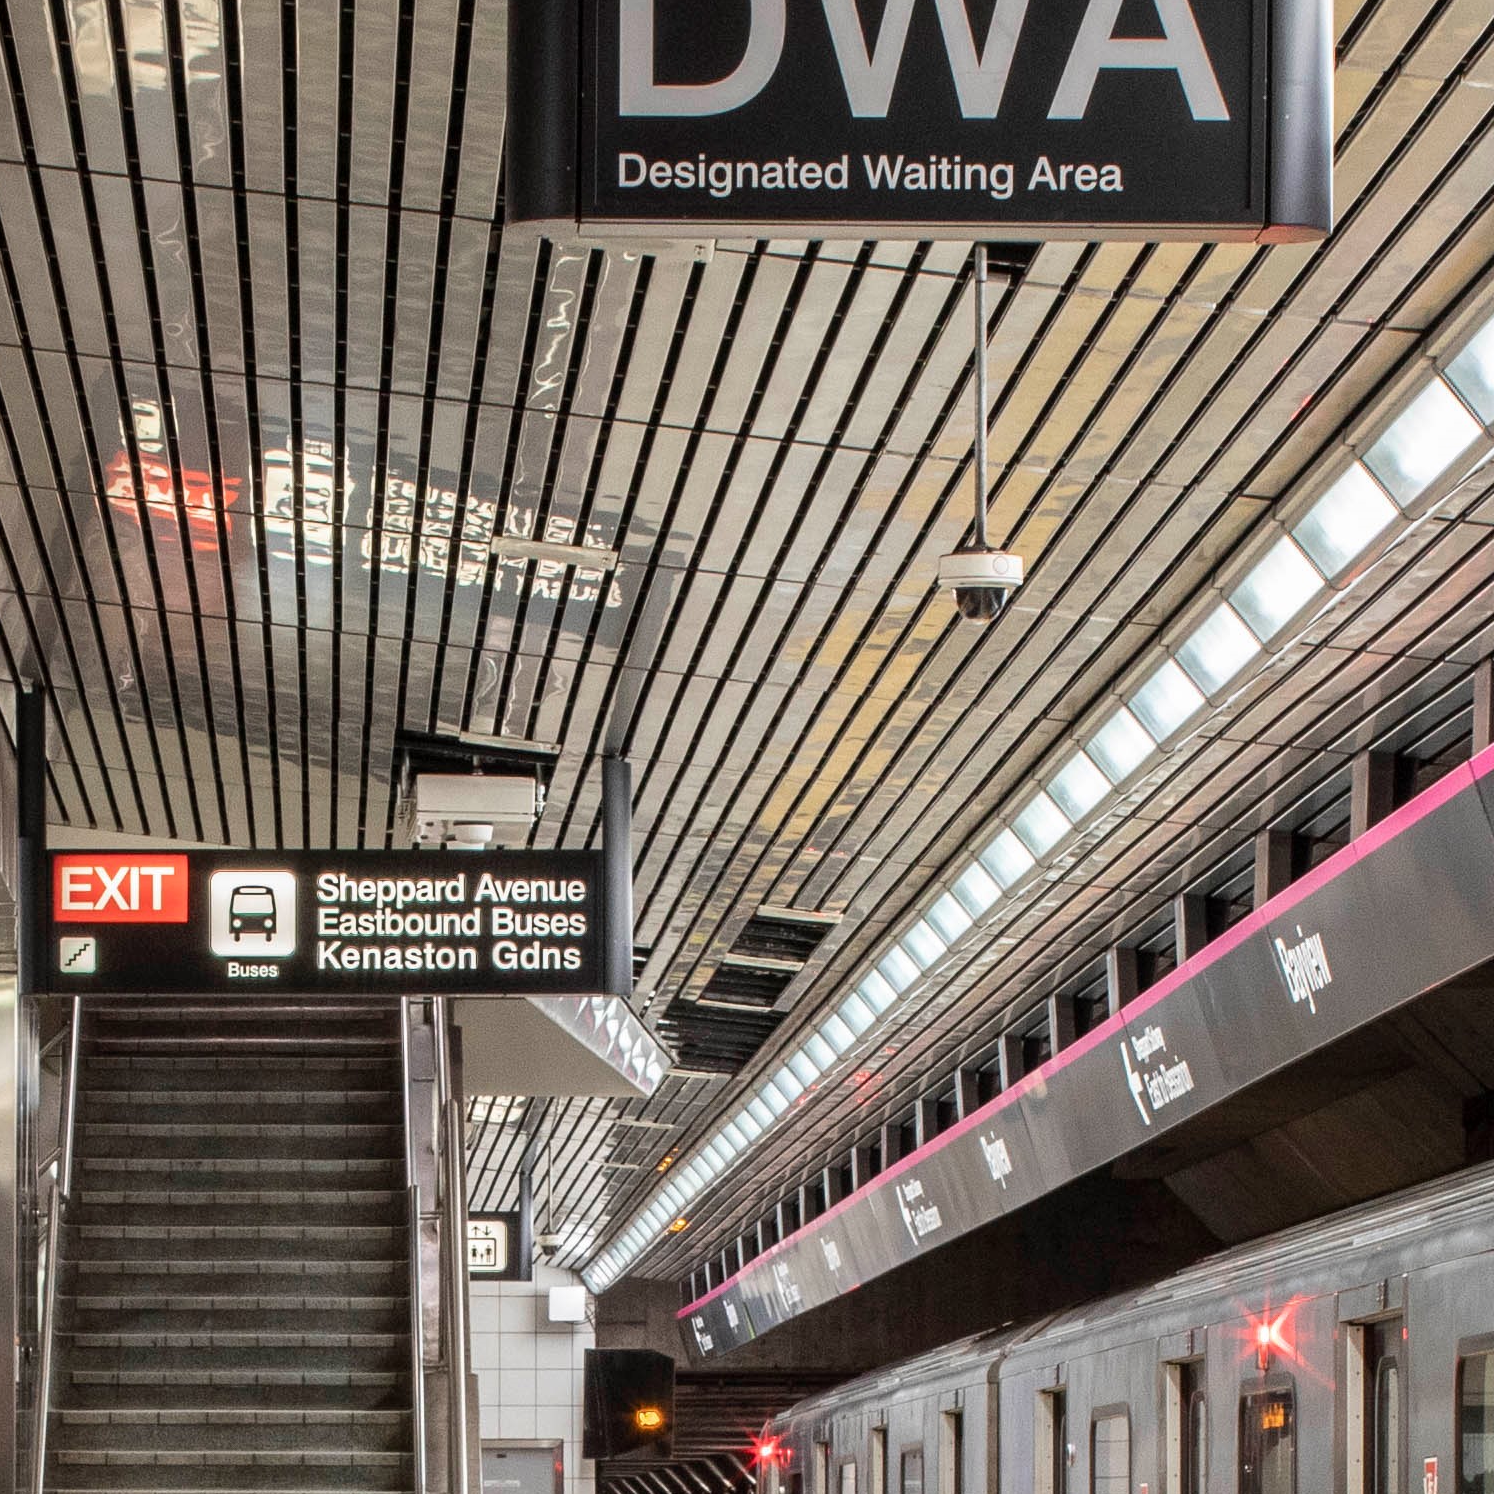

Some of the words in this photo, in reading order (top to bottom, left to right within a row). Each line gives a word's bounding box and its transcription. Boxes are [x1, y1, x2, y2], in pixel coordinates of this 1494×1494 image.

[618, 152, 848, 197] Designated
[862, 153, 1016, 199] Waiting
[1027, 156, 1124, 193] Area
[61, 866, 175, 911] EXIT
[316, 873, 466, 909] Sheppard
[474, 873, 586, 903] Avenue
[317, 907, 481, 936] Eastbound
[491, 907, 586, 937] Buses
[227, 962, 280, 979] Buses
[317, 941, 478, 970] Kenaston
[492, 941, 582, 970] Gdns
